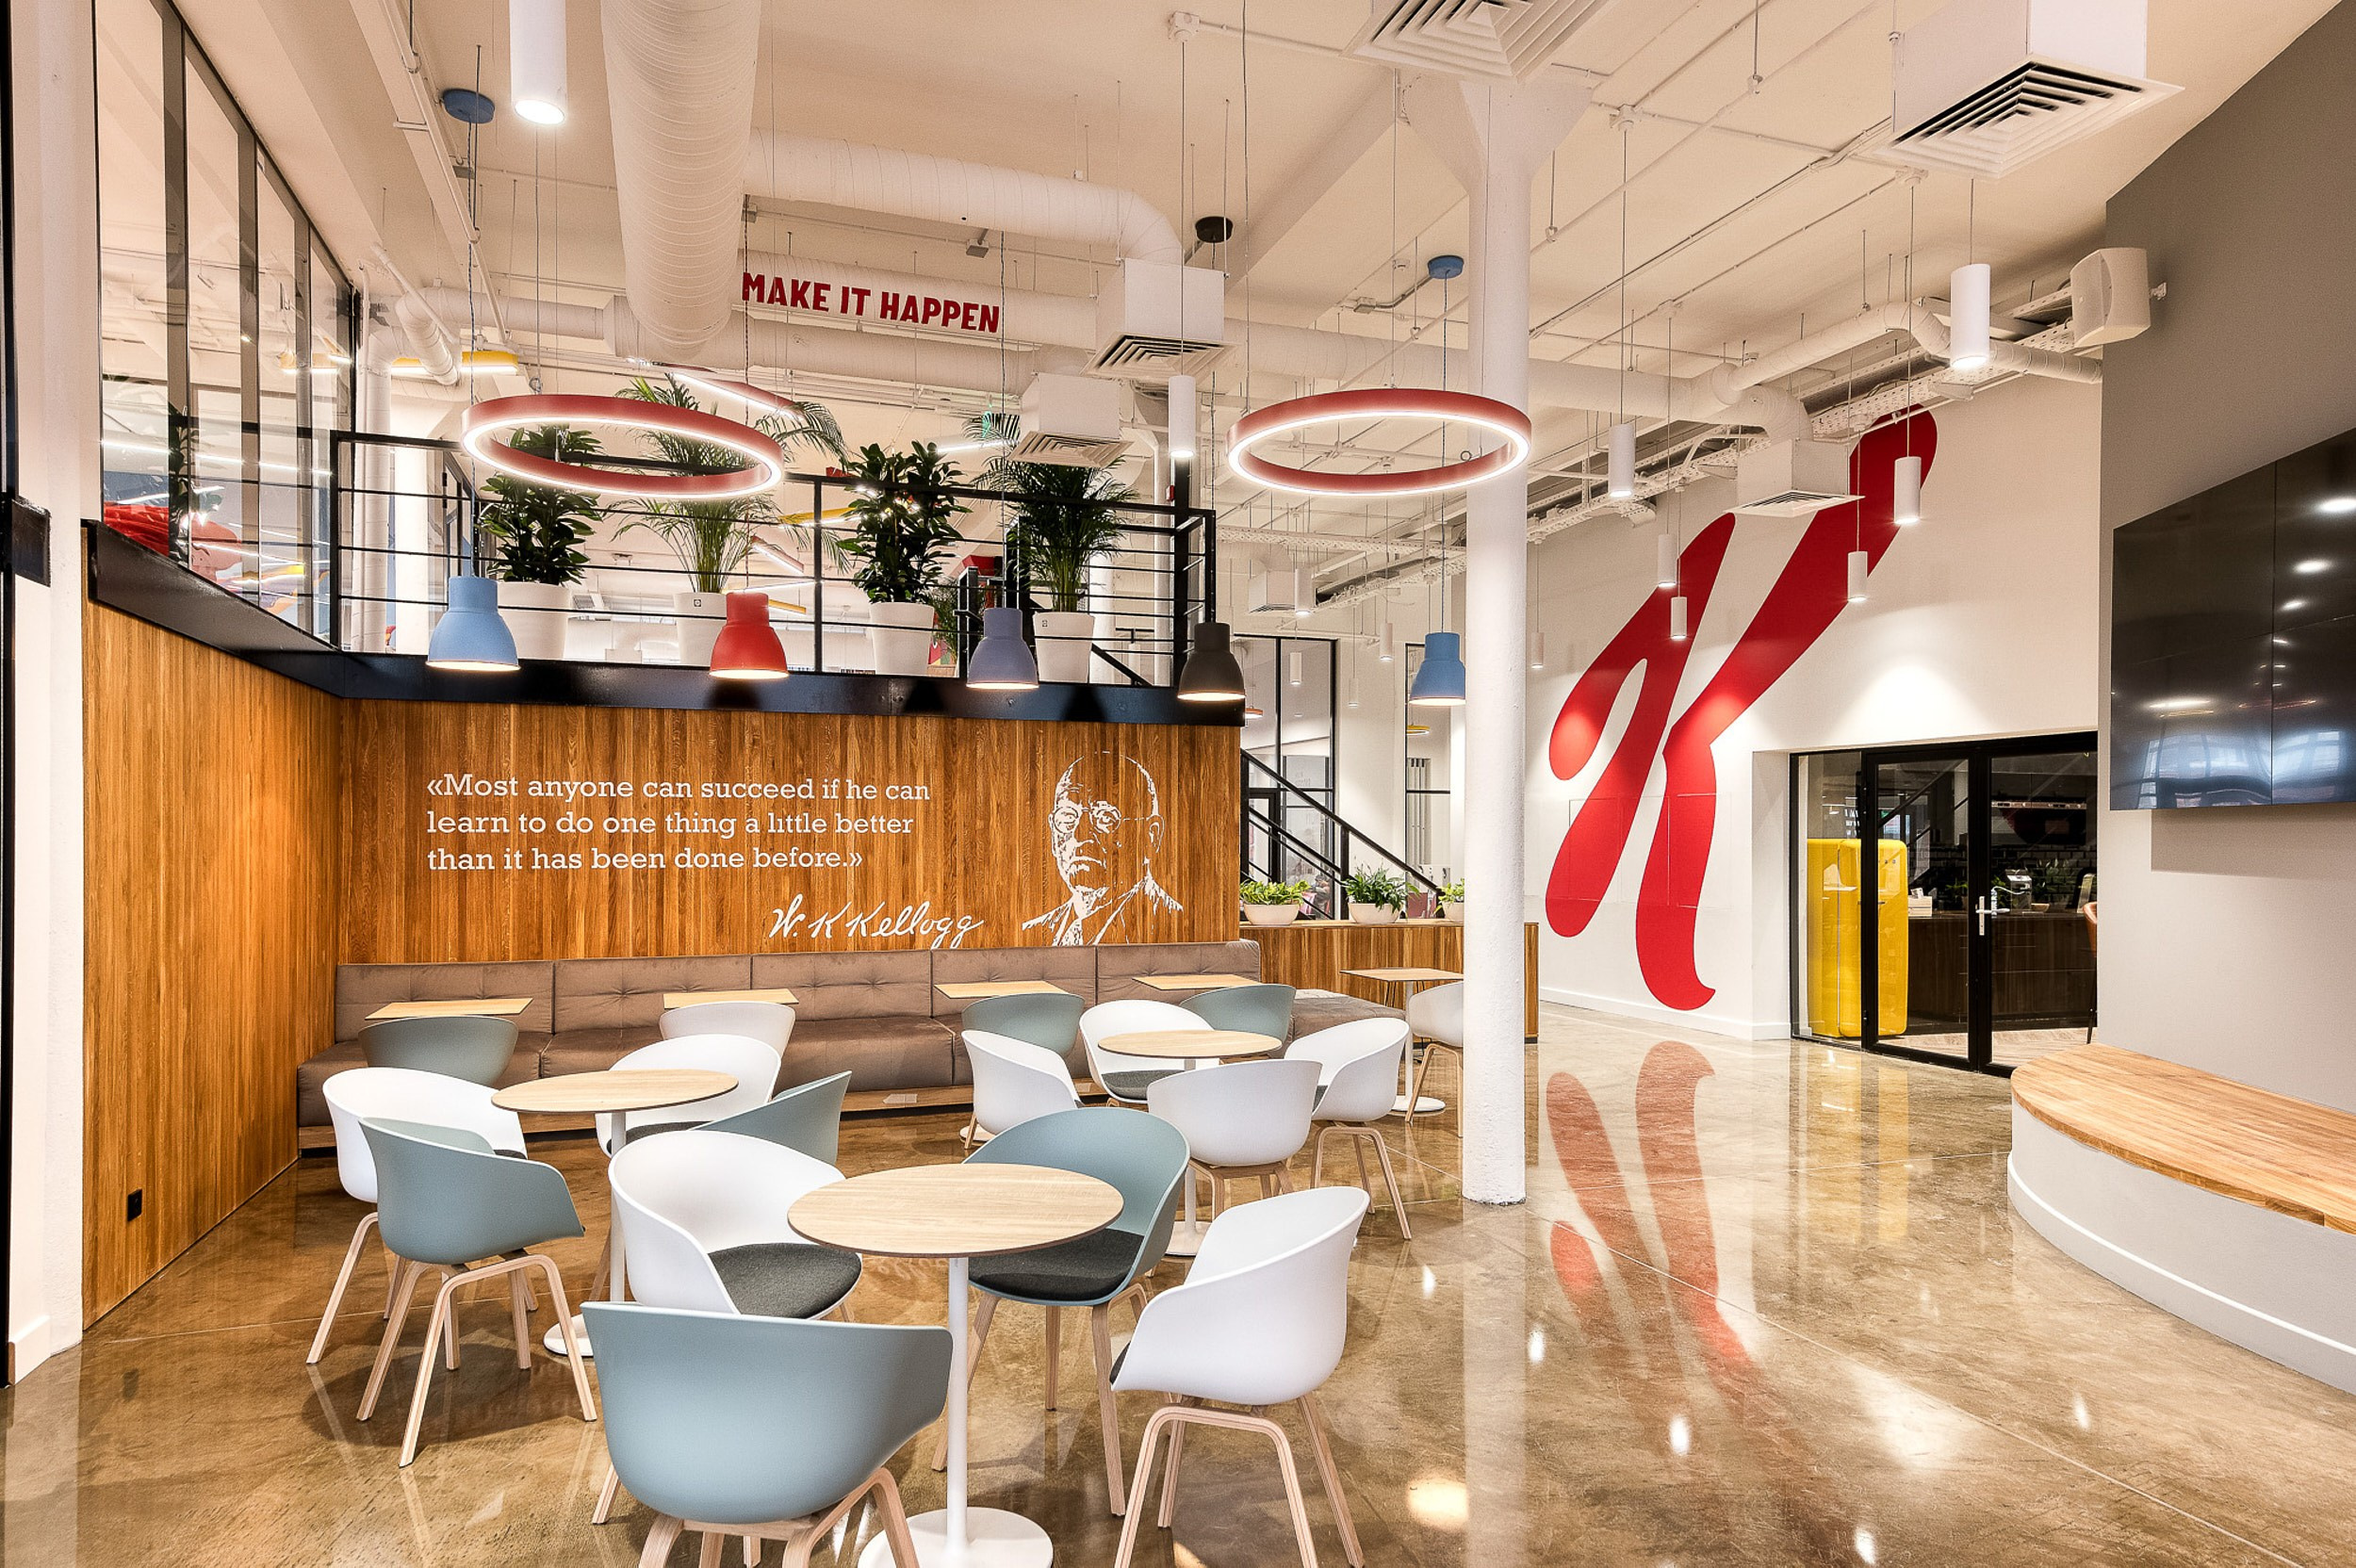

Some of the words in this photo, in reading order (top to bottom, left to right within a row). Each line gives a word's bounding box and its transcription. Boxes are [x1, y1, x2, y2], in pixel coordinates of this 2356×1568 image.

[743, 272, 831, 312] MAKE
[841, 286, 871, 316] IT
[880, 291, 1000, 333] HAPPEN
[427, 773, 518, 796] «Most
[528, 780, 634, 803] anyone
[642, 781, 694, 798] can
[701, 778, 815, 800] succeed
[822, 778, 841, 799] if
[845, 779, 877, 799] he
[885, 784, 930, 800] can
[427, 810, 510, 833] learn
[518, 811, 547, 833] to
[556, 811, 594, 833] do
[602, 816, 656, 833] one
[664, 812, 737, 840] thing
[744, 818, 761, 833] a
[767, 812, 827, 833] little
[835, 813, 914, 833] better
[427, 848, 495, 870] than
[503, 848, 523, 870] it
[532, 848, 582, 869] has
[591, 848, 665, 869] been
[674, 848, 744, 869] done
[752, 846, 863, 868] before.»
[769, 893, 806, 939] W.
[844, 901, 985, 950] Kellogg
